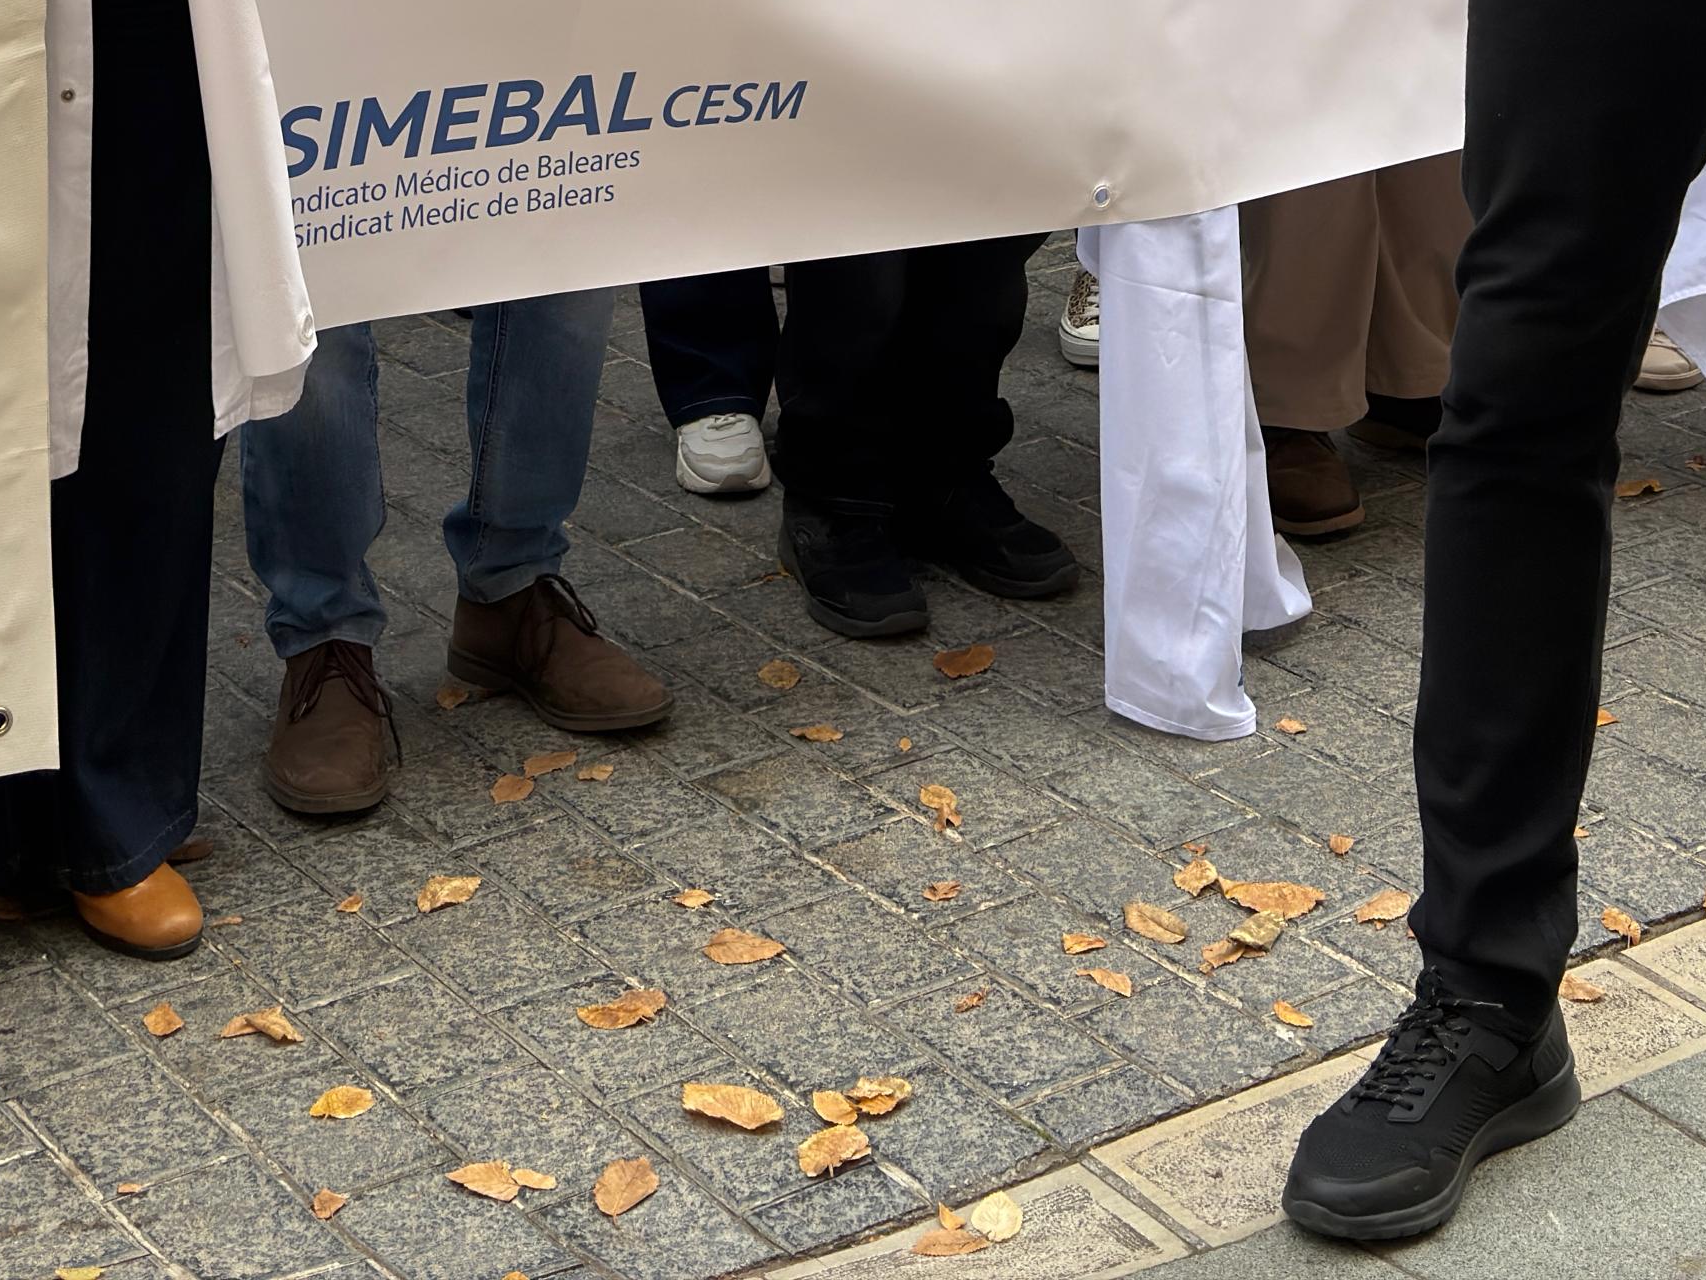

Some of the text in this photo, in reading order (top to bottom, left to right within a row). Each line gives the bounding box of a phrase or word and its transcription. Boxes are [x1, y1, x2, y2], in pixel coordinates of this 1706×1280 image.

[280, 71, 808, 178] SIMEBAL CESM
[291, 145, 640, 215] ndicato Médico de Baleares
[401, 197, 480, 231] Medic
[487, 189, 519, 217] de
[527, 179, 615, 213] Balears
